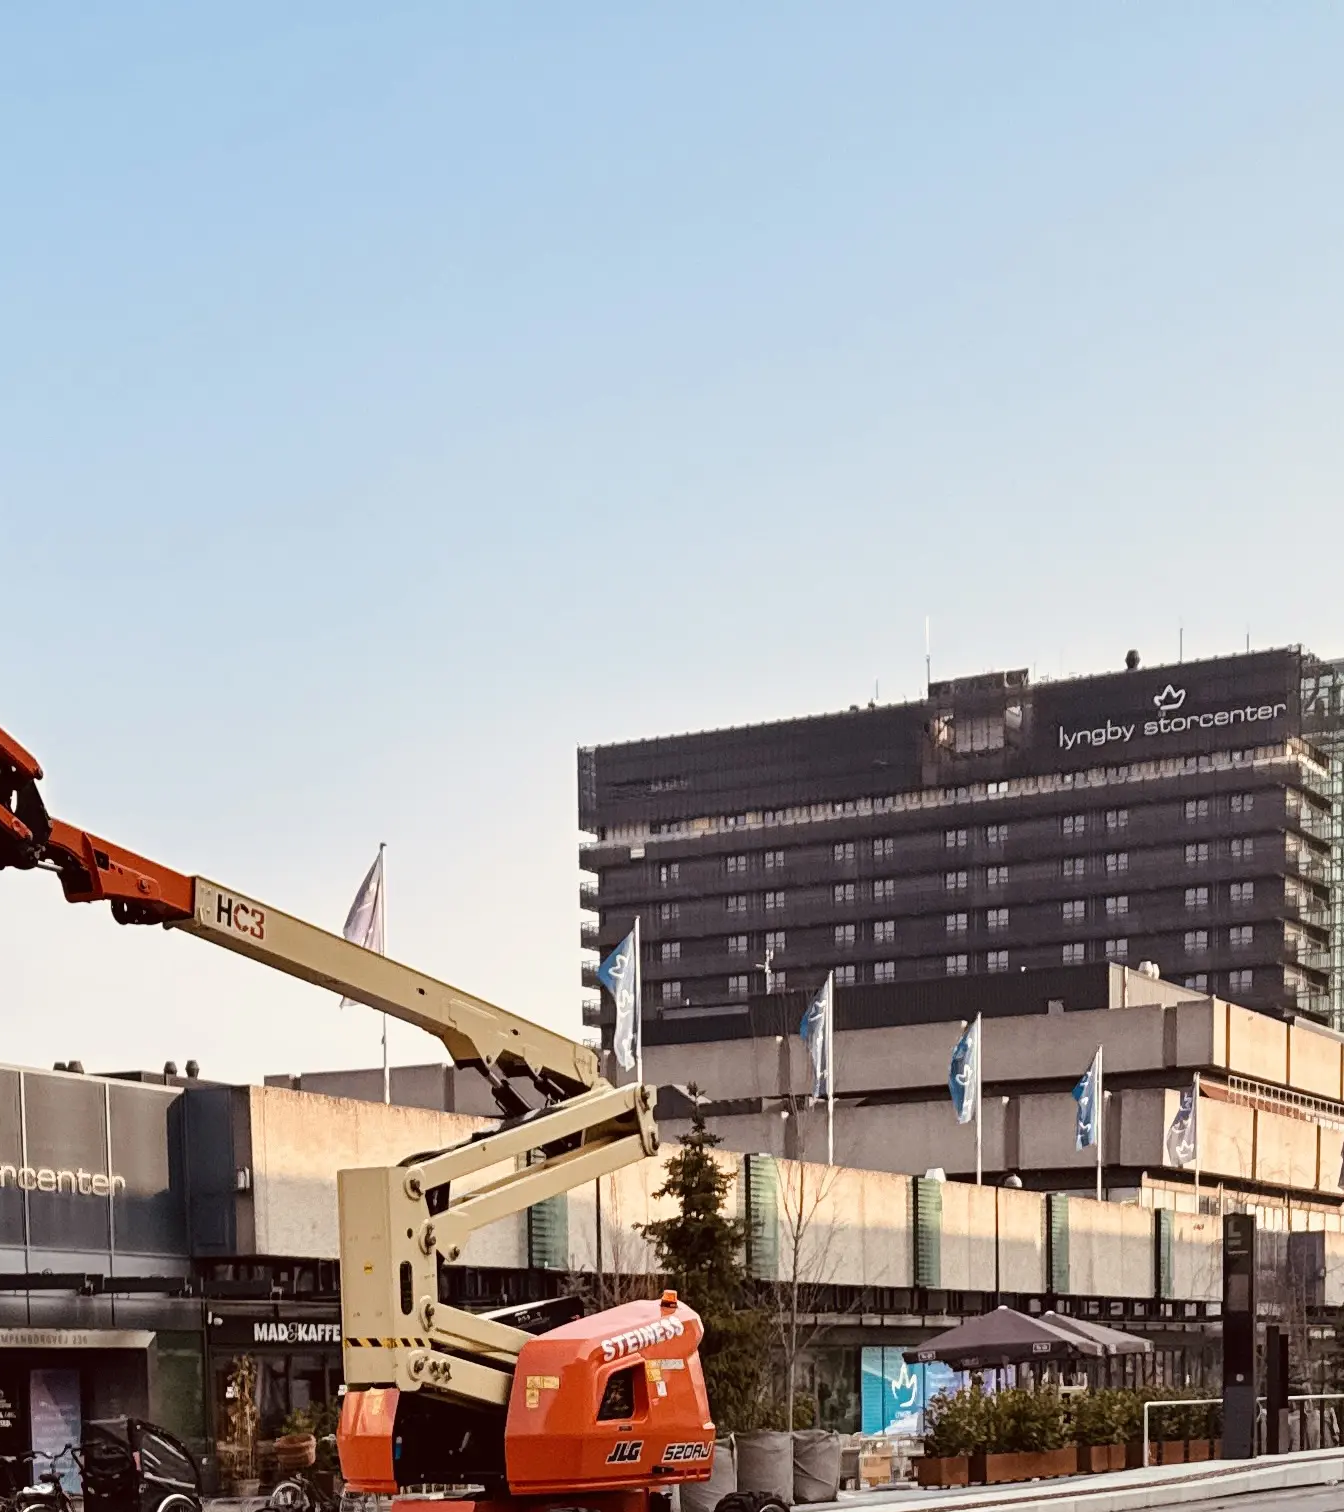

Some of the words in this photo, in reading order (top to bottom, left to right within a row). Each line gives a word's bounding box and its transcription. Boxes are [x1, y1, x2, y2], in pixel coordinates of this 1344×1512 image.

[1059, 720, 1135, 749] lyngby
[1144, 704, 1286, 735] storcenter
[217, 894, 264, 939] HC3
[601, 1316, 684, 1361] STEINESS
[607, 1442, 643, 1462] JLG
